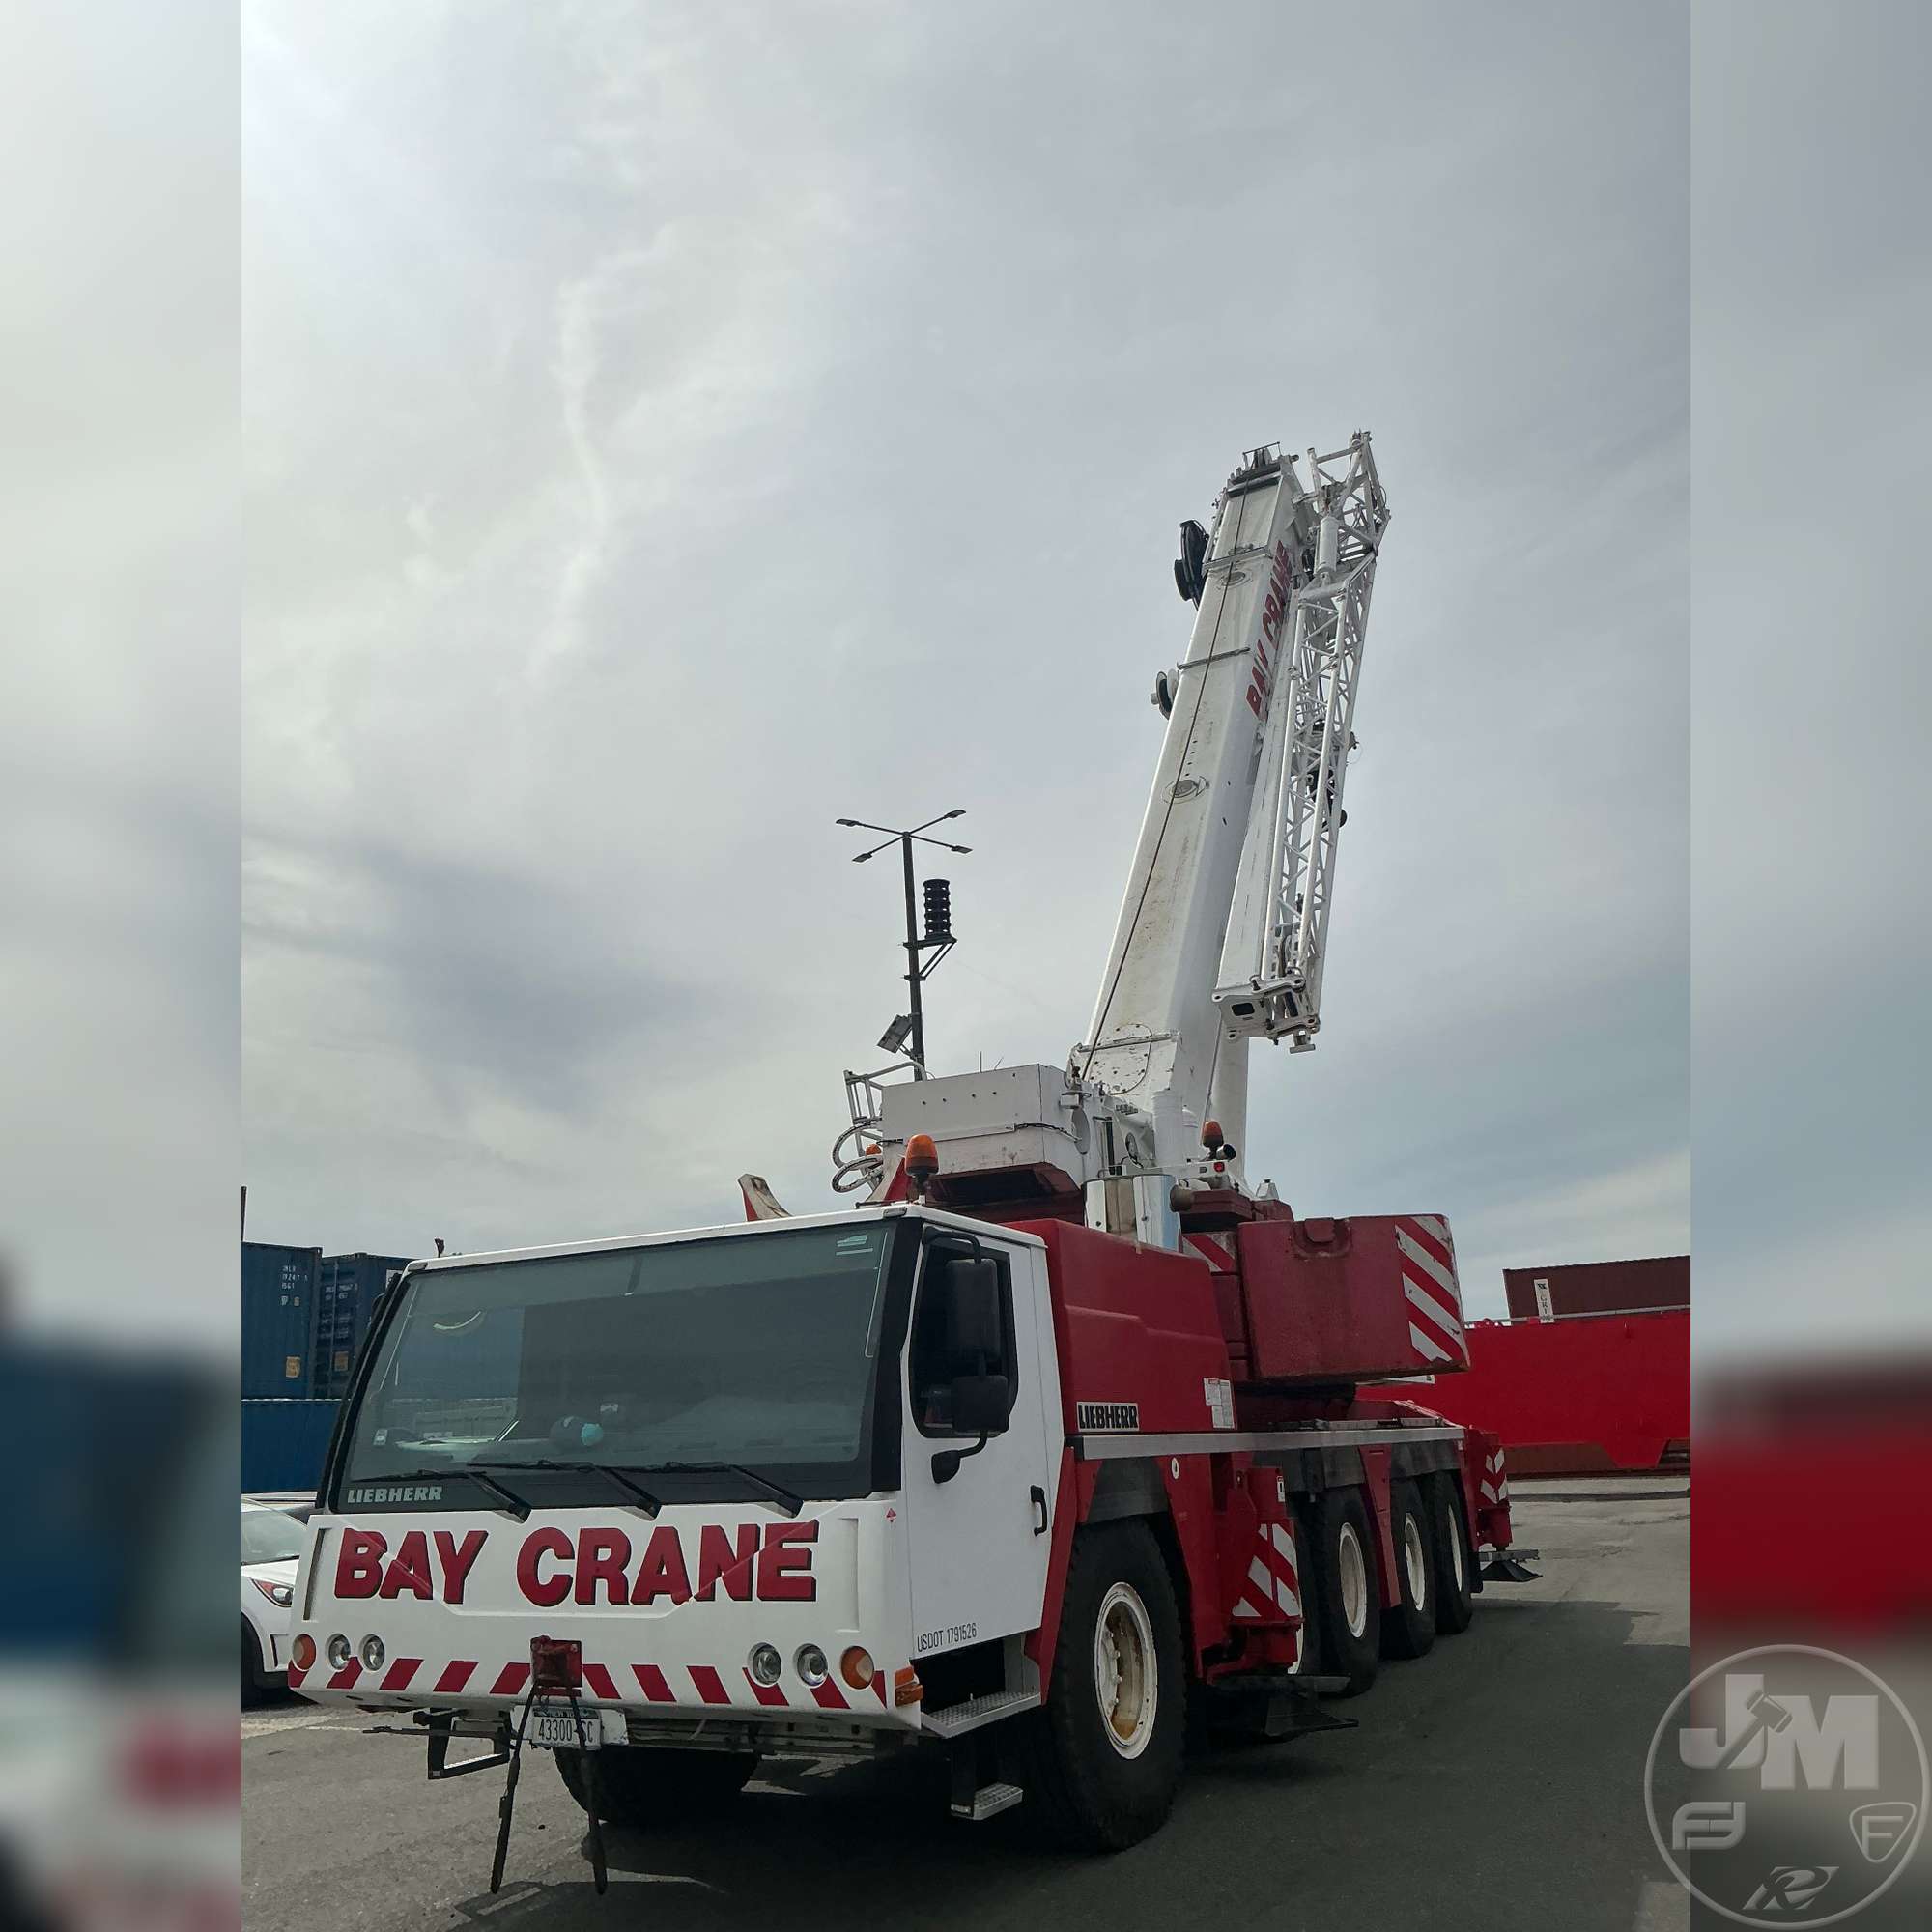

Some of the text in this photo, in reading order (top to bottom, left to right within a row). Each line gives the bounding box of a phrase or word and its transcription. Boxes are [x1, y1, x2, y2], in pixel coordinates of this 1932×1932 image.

[1078, 1405, 1139, 1429] LIEBHERR
[348, 1486, 442, 1504] LIEBHERR
[333, 1520, 819, 1607] BAY CRANE
[917, 1623, 977, 1652] USDOT 1791526
